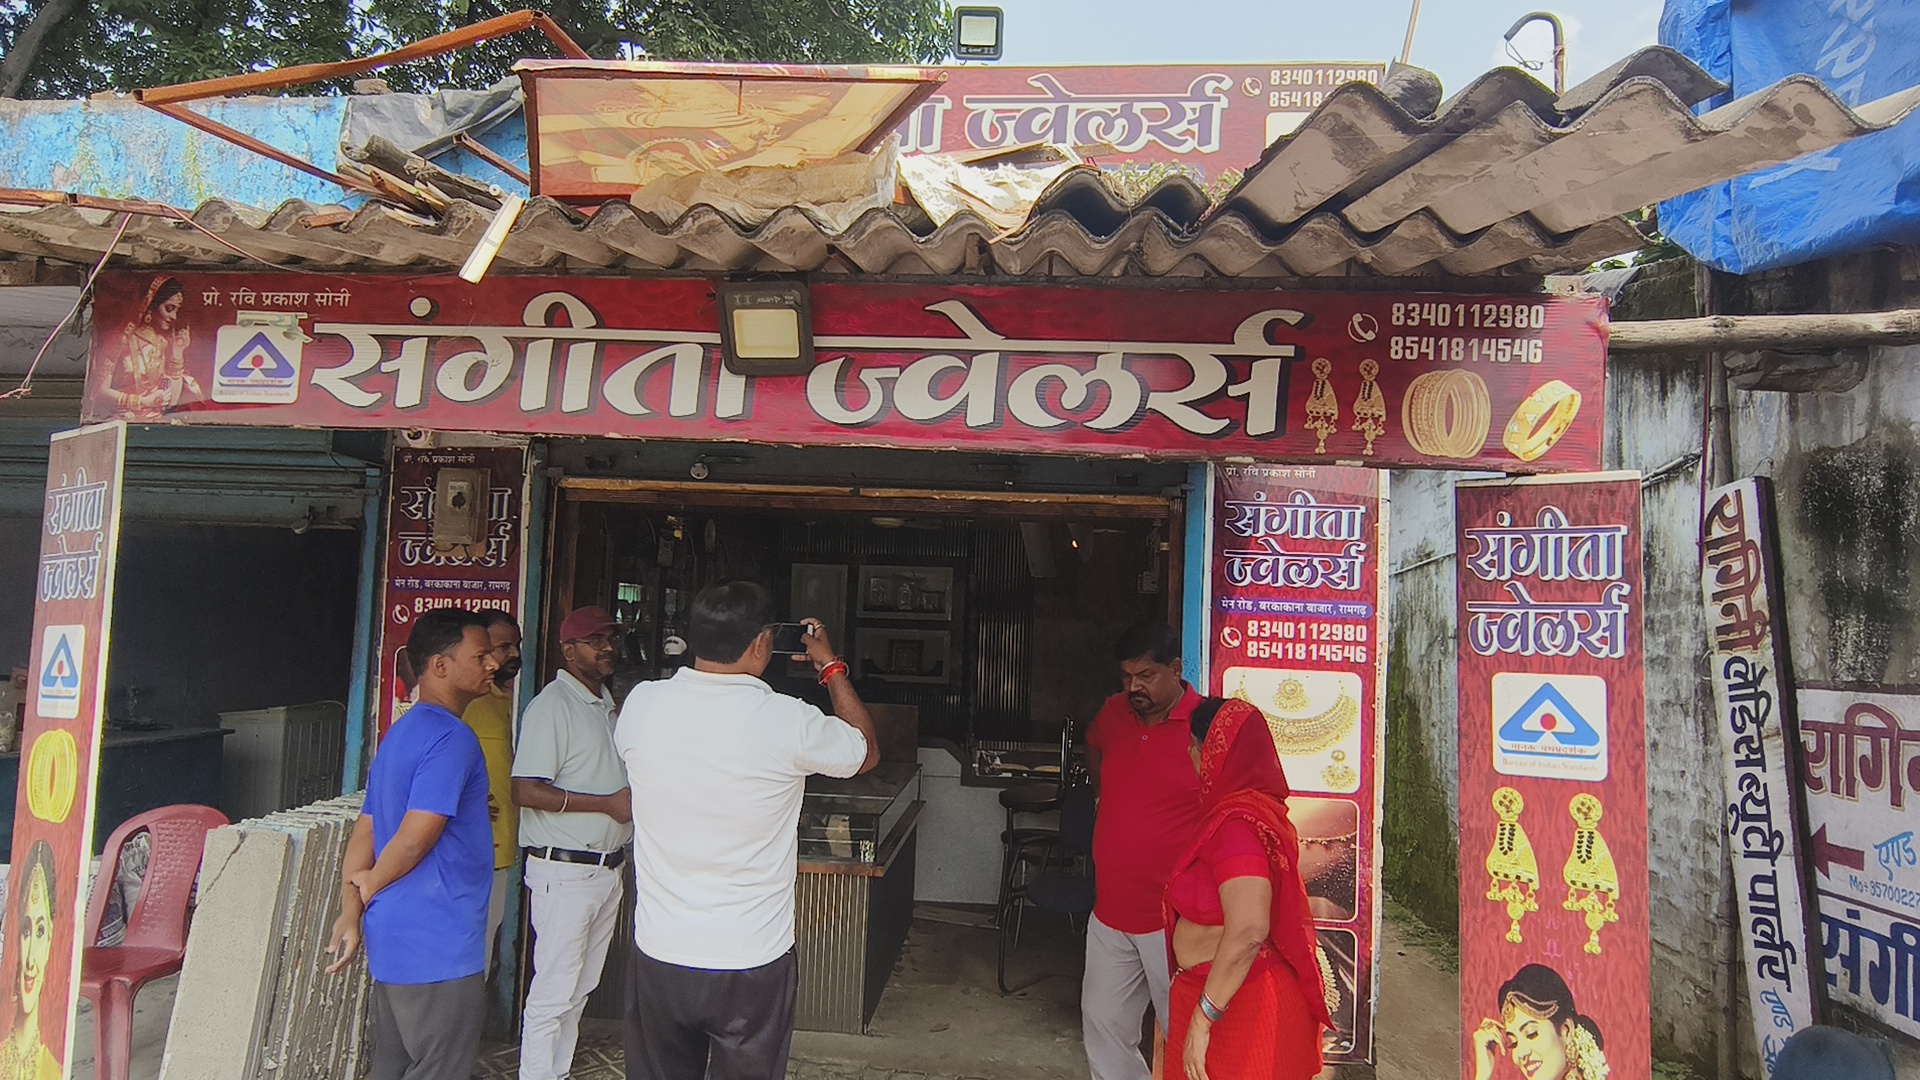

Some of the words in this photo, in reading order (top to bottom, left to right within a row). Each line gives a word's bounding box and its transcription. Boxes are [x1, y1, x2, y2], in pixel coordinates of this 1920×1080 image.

[1270, 69, 1378, 86] 8340112980
[963, 73, 1233, 154] ज्वेलर्स
[202, 287, 223, 307] प्रो.
[229, 287, 257, 307] रवि
[261, 290, 309, 307] प्रकाश
[314, 287, 351, 307] सोनी
[1391, 303, 1545, 329] 8340112980
[310, 291, 745, 420] संगीता
[806, 300, 1304, 437] ज्वेलर्स
[1390, 336, 1543, 364] 8541814546
[47, 466, 108, 536] संगीता
[1262, 468, 1291, 479] प्रकाश
[1294, 466, 1317, 480] सोनी
[1224, 490, 1368, 542] संगीता
[1465, 505, 1629, 582] संगीता
[40, 531, 104, 603] ज्वेलर्स
[1224, 537, 1367, 591] ज्वेलर्स
[1703, 489, 1767, 655] रागिनी
[1247, 620, 1367, 642] 8340112980
[1465, 580, 1631, 660] ज्वेलर्स
[1247, 641, 1367, 663] 8541814546
[1723, 656, 1771, 772] लेडिस
[1748, 869, 1797, 993] पार्लर
